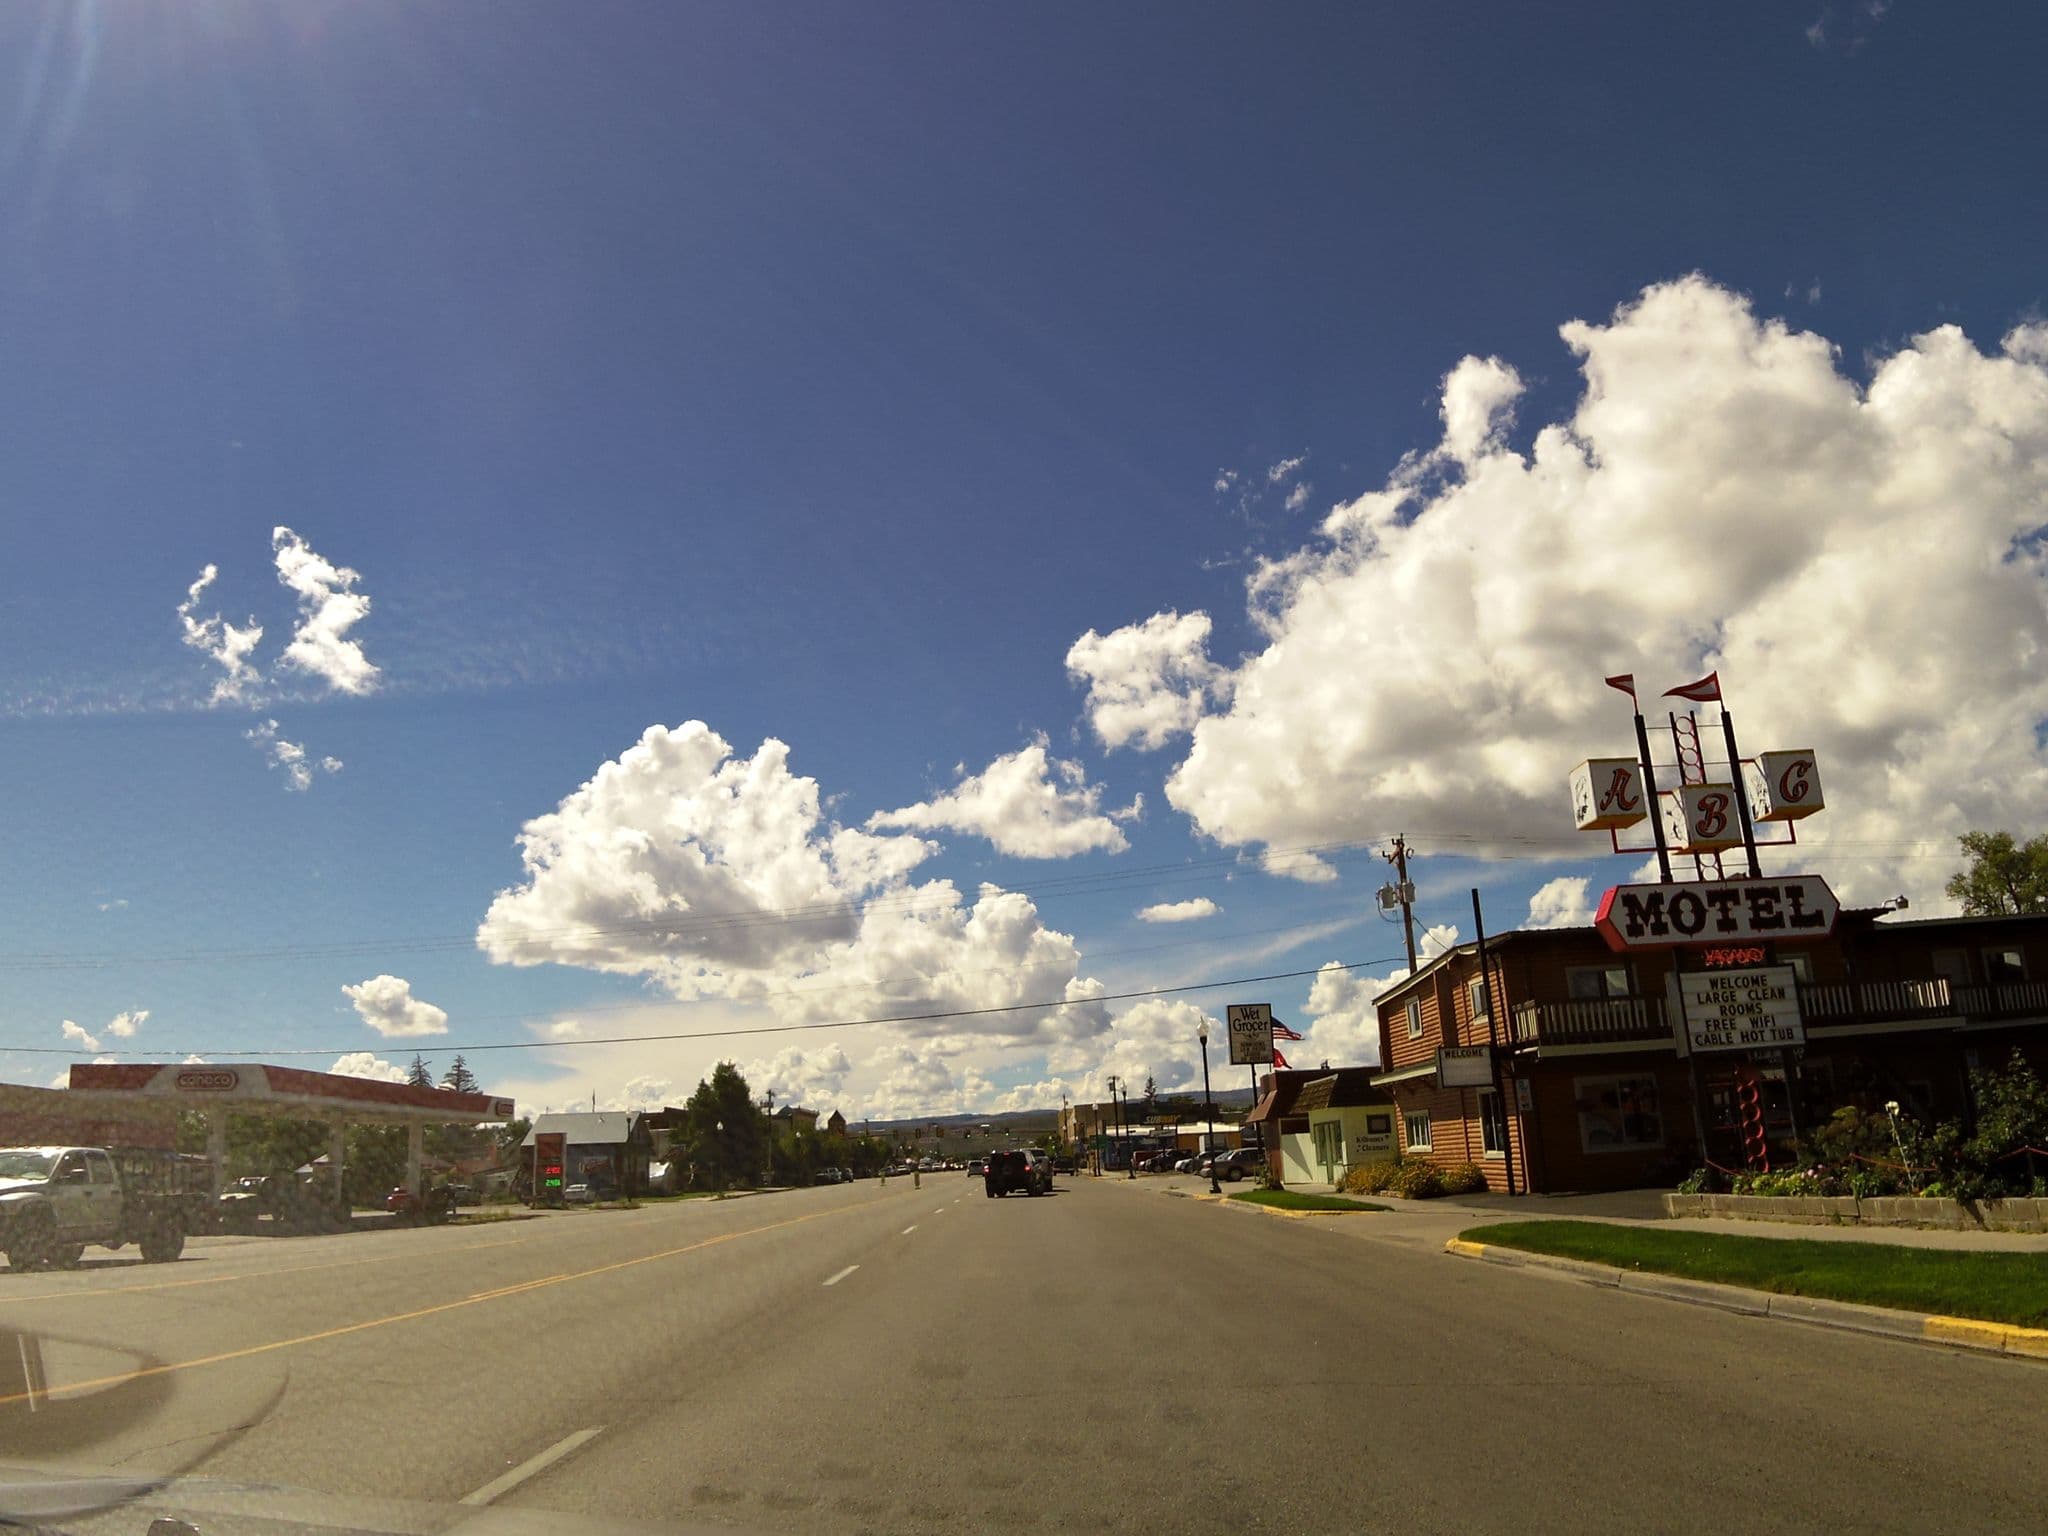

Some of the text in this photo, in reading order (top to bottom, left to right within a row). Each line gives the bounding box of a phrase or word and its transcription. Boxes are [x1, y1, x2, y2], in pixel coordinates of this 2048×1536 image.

[1600, 768, 1640, 812] A
[1695, 792, 1729, 838] B
[1779, 759, 1813, 803] C
[1620, 885, 1826, 938] MOTEL
[1709, 975, 1768, 990] WELCOME
[1697, 987, 1786, 1005] LARGE CLEAN
[1719, 1002, 1763, 1017] ROOMS
[1232, 1018, 1268, 1032] Grocer
[1705, 1015, 1776, 1033] FREE WIFI
[1695, 1028, 1795, 1047] CABLE HOT TUB
[1443, 1048, 1484, 1059] WELCOME
